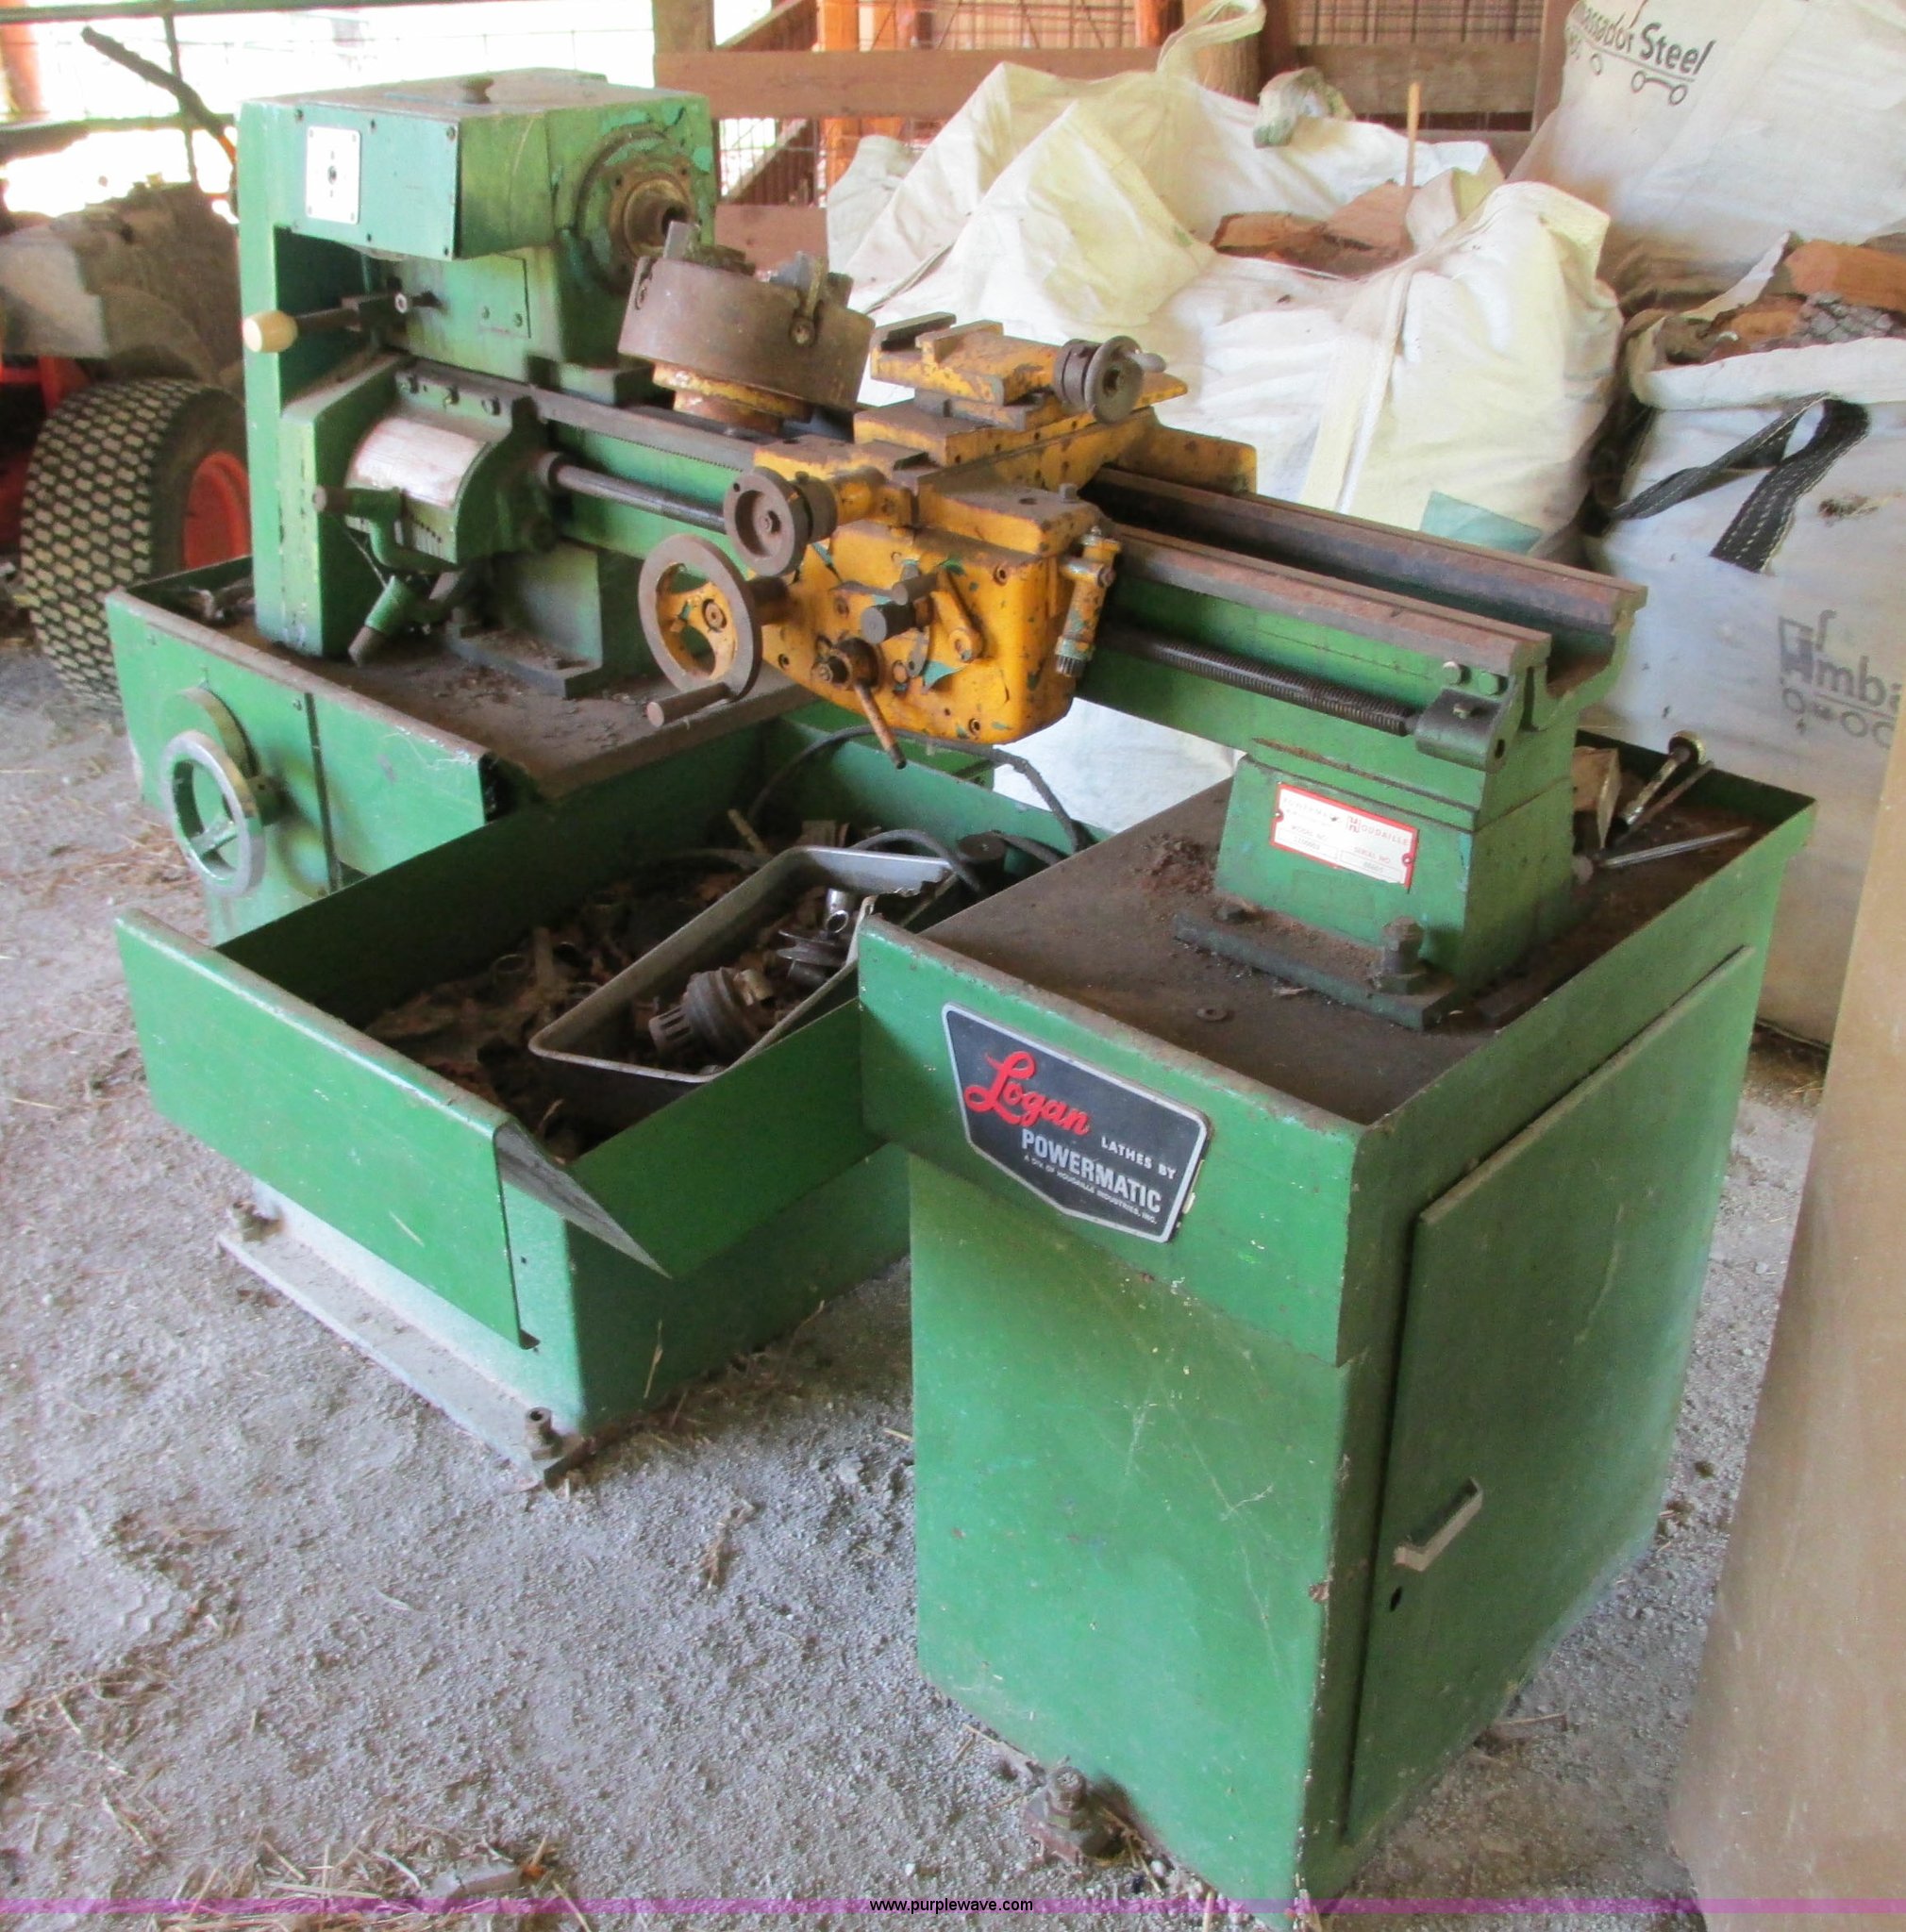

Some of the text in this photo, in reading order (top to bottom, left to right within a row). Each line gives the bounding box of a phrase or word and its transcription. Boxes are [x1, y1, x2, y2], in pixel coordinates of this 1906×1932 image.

[1640, 23, 1716, 75] Steel
[964, 1051, 1091, 1135] Logan
[1021, 1128, 1162, 1213] POWERMATIC
[1101, 1136, 1177, 1179] LATHES BY
